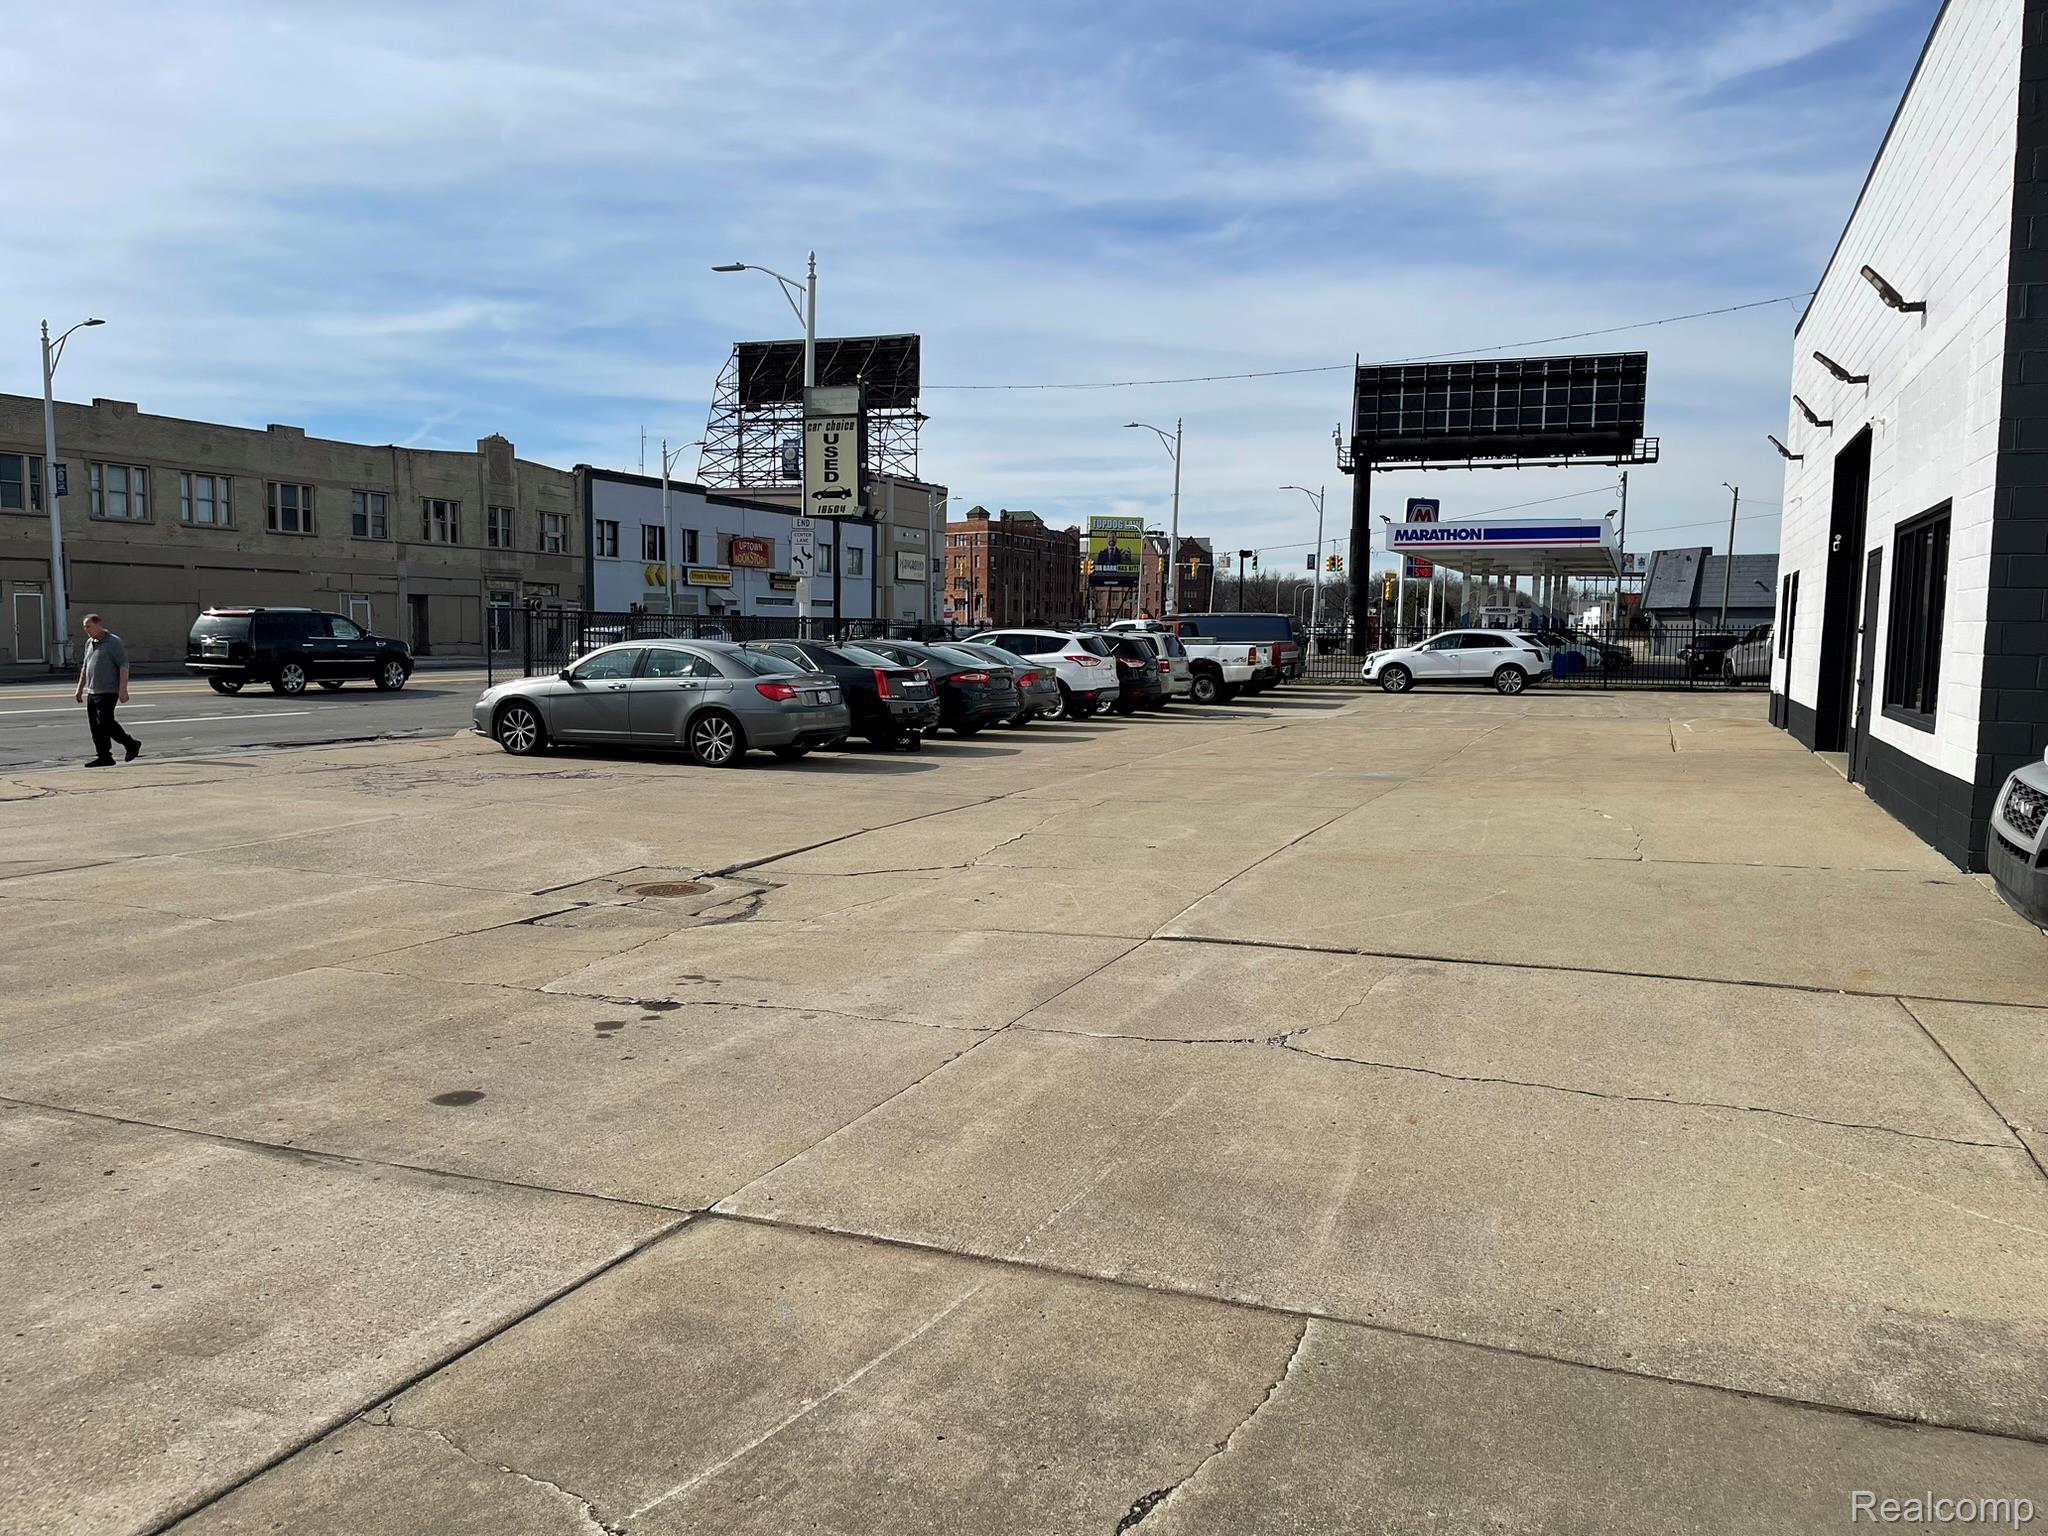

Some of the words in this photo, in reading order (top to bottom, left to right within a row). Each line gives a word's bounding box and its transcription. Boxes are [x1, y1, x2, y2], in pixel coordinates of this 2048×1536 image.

[807, 423, 822, 432] car
[825, 420, 855, 432] choice
[823, 433, 840, 483] USED
[797, 519, 810, 527] END
[1093, 519, 1123, 529] TOPDOG
[1394, 528, 1483, 541] MARATHON
[739, 541, 763, 551] UPTOWN
